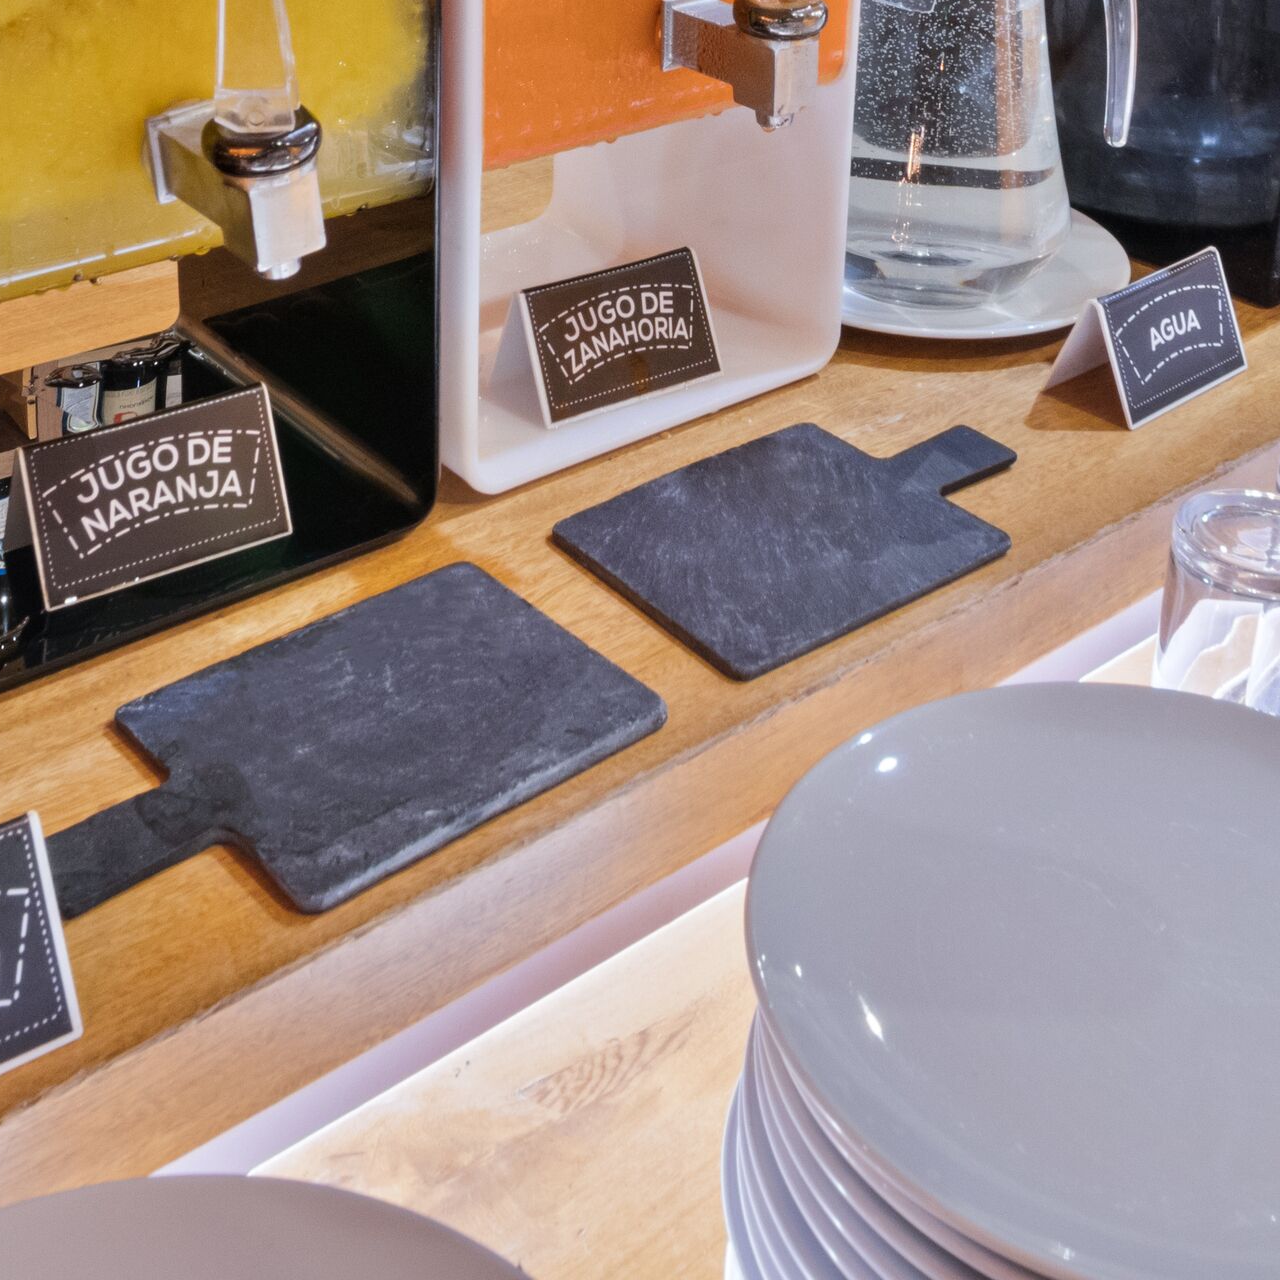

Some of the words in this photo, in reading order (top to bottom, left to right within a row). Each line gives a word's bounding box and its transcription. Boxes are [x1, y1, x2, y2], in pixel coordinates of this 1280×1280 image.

[564, 295, 636, 342] JUGO
[641, 291, 674, 315] DE
[1150, 309, 1202, 352] AGUA
[564, 317, 689, 374] ZANAHORIA
[77, 443, 180, 504] JUGO
[188, 436, 233, 466] DE
[80, 470, 242, 541] NARANJA
